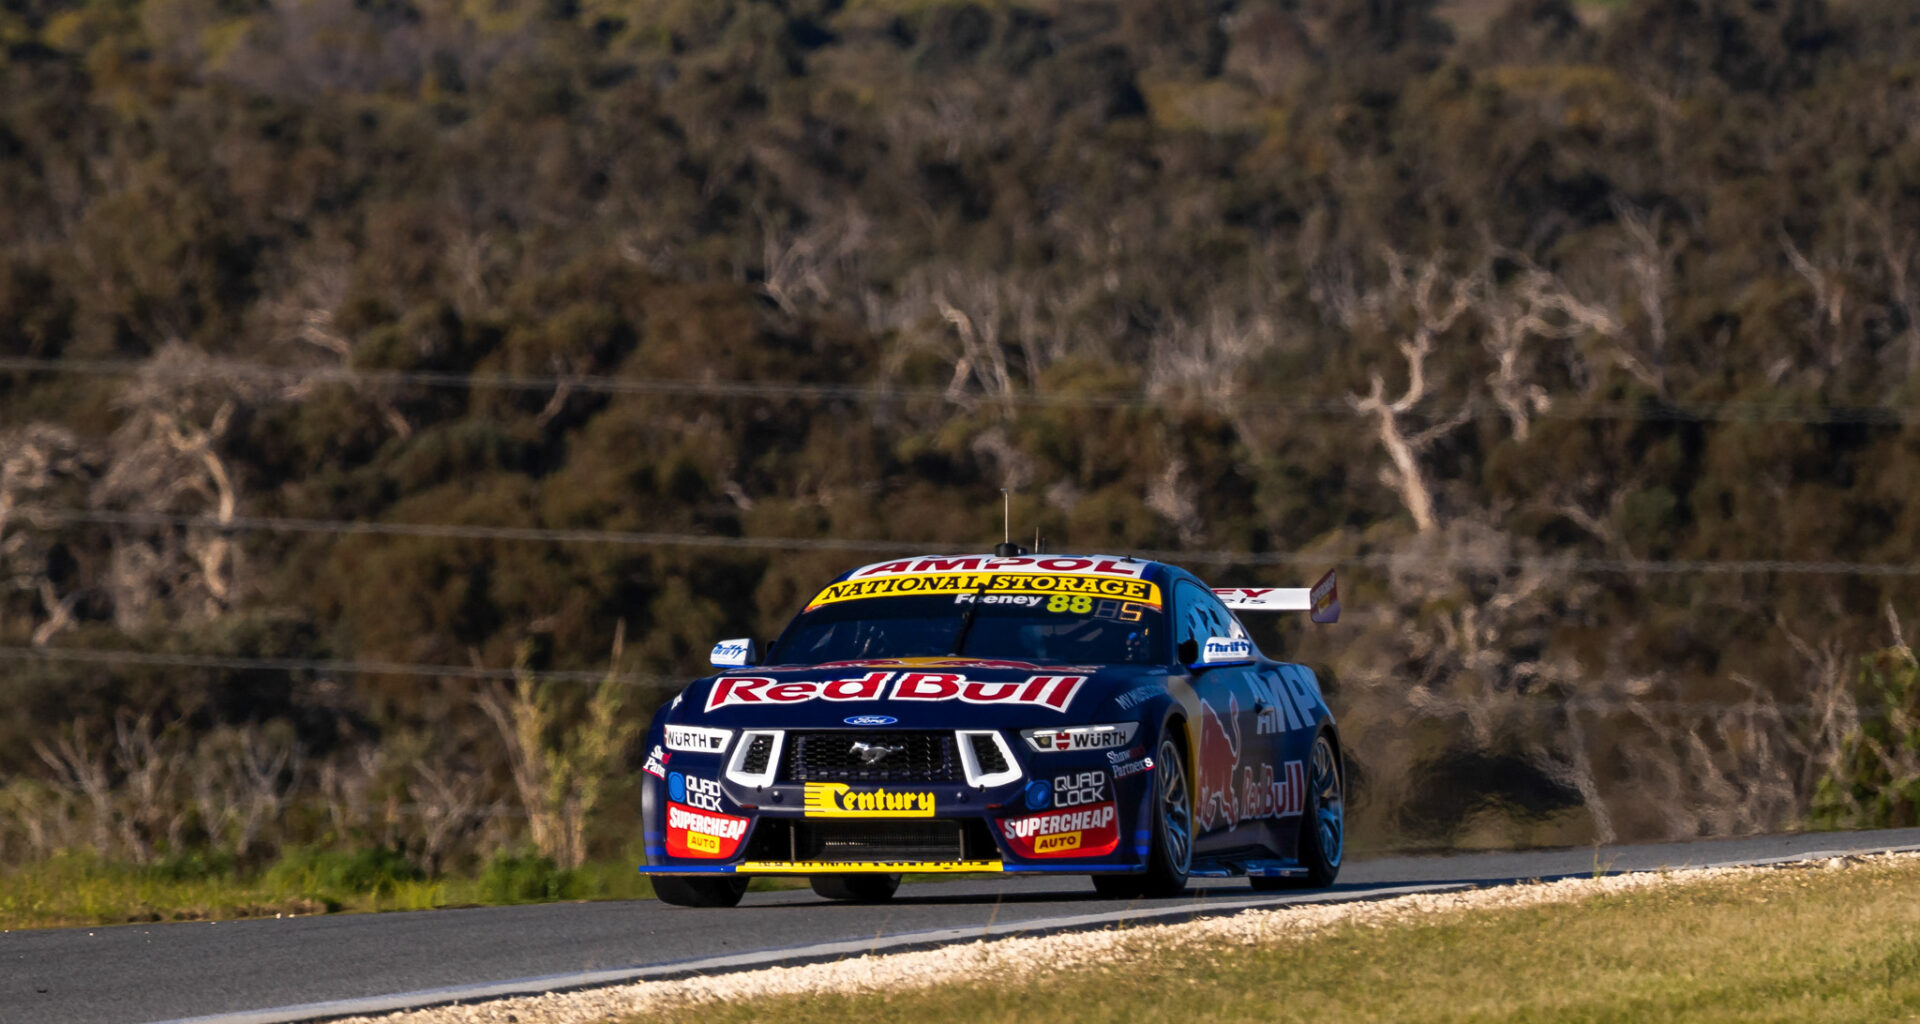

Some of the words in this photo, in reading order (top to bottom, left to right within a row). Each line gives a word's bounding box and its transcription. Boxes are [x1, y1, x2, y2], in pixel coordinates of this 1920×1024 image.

[860, 557, 1136, 576] AMPOL
[823, 575, 980, 601] NATIONAL
[991, 574, 1148, 599] STORAGE
[954, 593, 1043, 607] Feeney
[1046, 594, 1093, 614] 88
[1206, 641, 1251, 656] Thrifty
[704, 671, 897, 713] Red
[888, 672, 1089, 713] Bull
[667, 732, 707, 748] WÜRTH
[1073, 731, 1127, 748] WÜRTH
[685, 775, 721, 797] QUAD
[1053, 771, 1105, 792] QUAD
[1240, 761, 1264, 820] Red
[1262, 760, 1305, 818] Bull
[686, 790, 724, 813] LOCK
[828, 783, 936, 817] Century
[1053, 786, 1105, 808] LOCK
[669, 807, 748, 841] SUPERCHEAP
[1004, 805, 1114, 840] SUPERCHEAP
[690, 836, 716, 849] AUTO
[1038, 835, 1077, 849] AUTO
